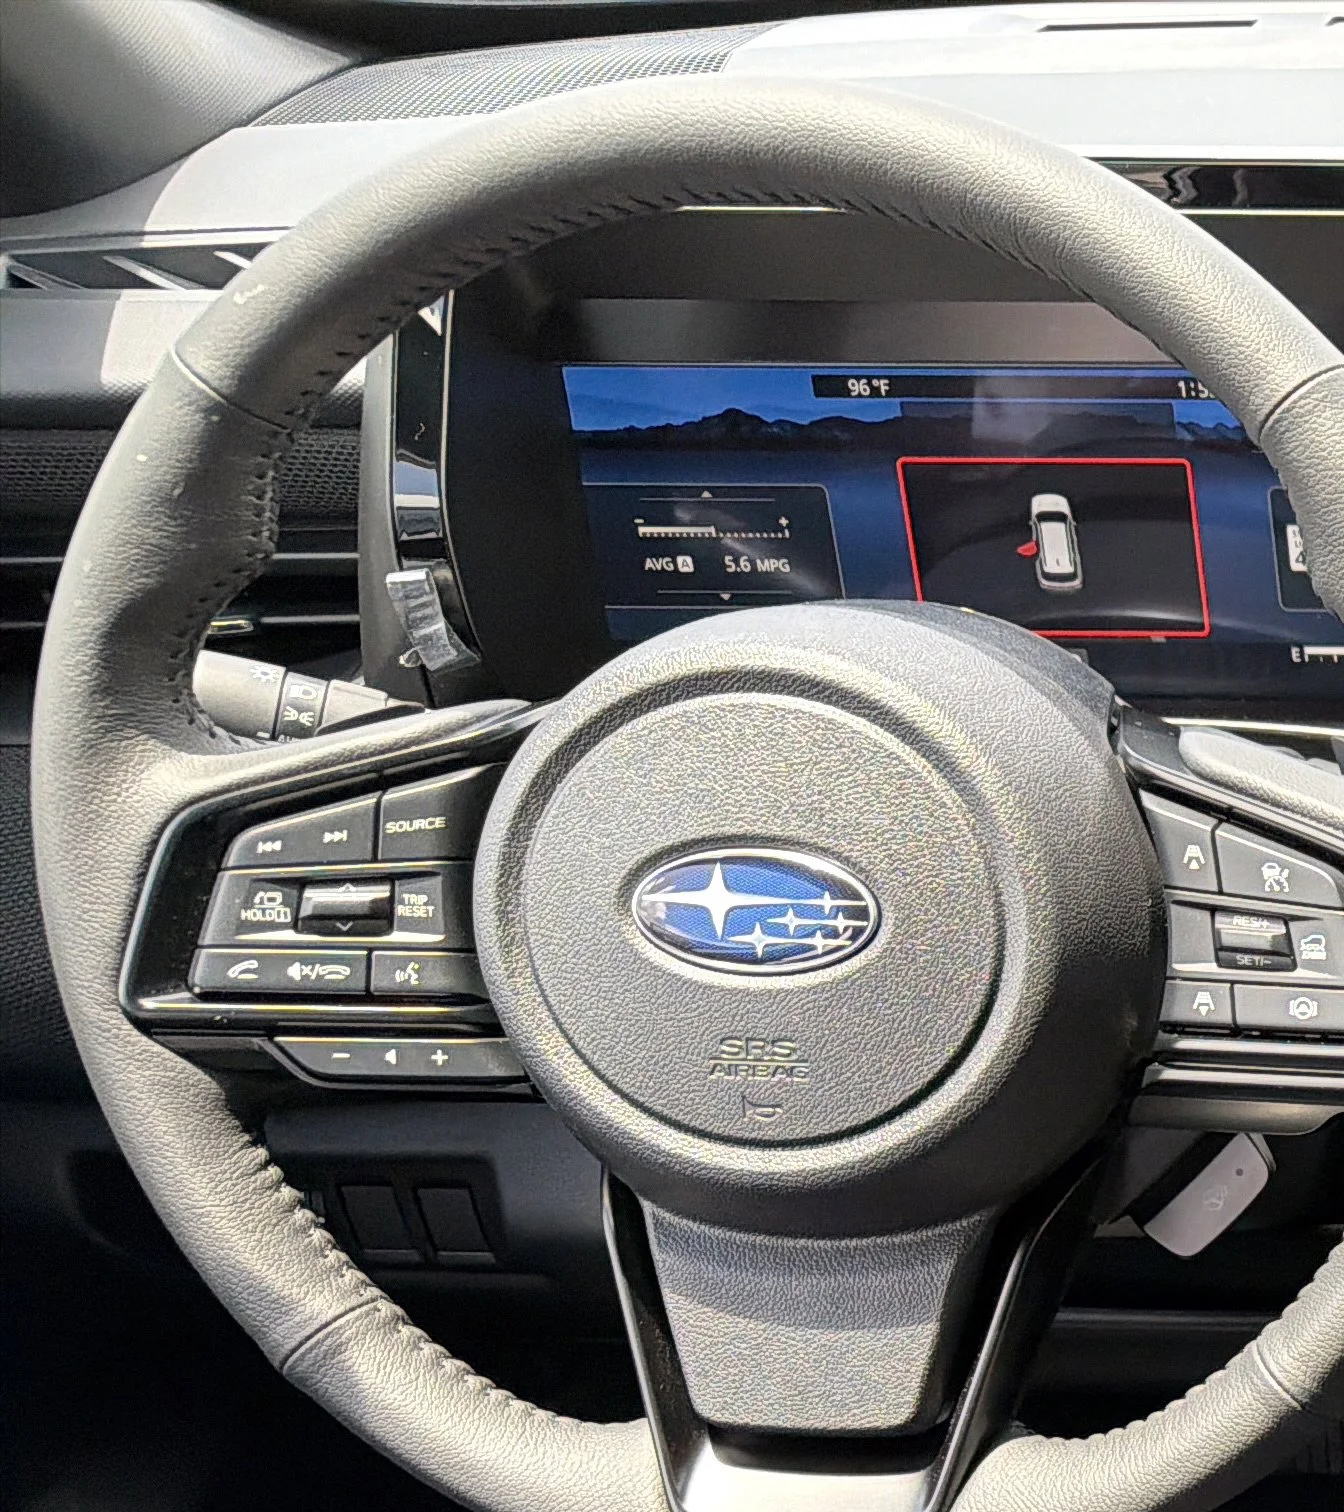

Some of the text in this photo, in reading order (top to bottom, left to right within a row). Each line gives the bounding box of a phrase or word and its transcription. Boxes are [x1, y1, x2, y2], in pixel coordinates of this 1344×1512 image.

[847, 378, 890, 397] 96°F
[1178, 380, 1215, 398] 1:5
[644, 557, 675, 572] AVG
[724, 556, 751, 572] 5.6
[756, 559, 791, 572] MPG
[385, 816, 446, 834] SOURCE
[402, 893, 429, 905] TRIP
[240, 908, 275, 921] HOLD
[397, 905, 435, 917] RESET
